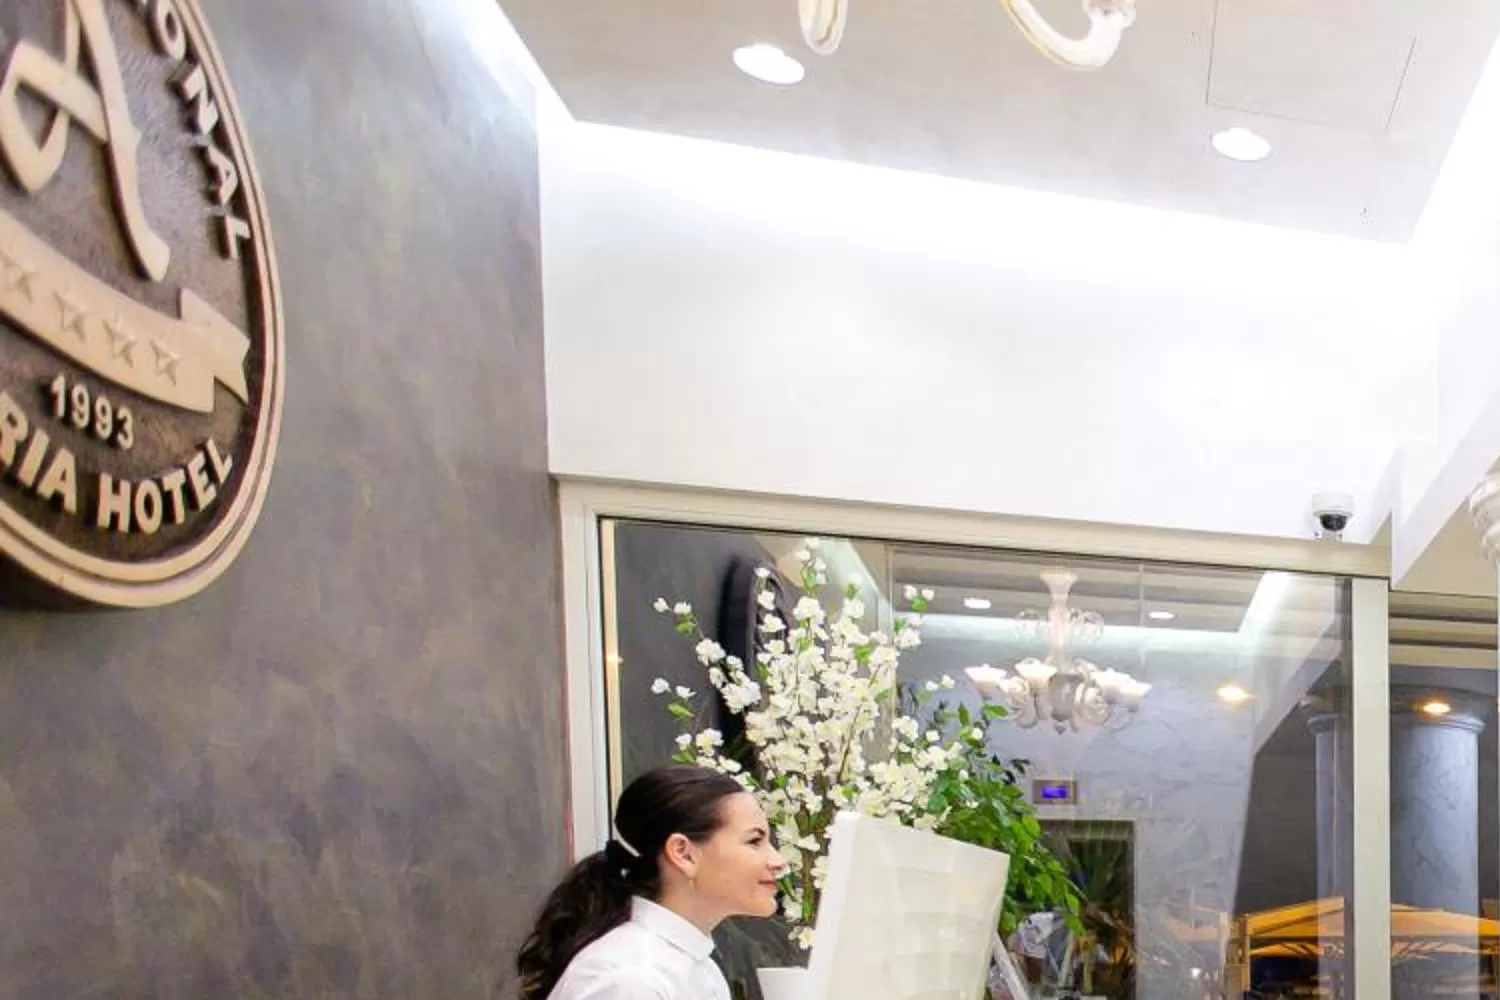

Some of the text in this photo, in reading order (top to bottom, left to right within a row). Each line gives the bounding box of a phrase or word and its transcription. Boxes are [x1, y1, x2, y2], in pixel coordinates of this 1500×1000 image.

[150, 0, 251, 259] ONAL
[52, 373, 133, 449] 1993
[97, 438, 232, 534] HOTEL
